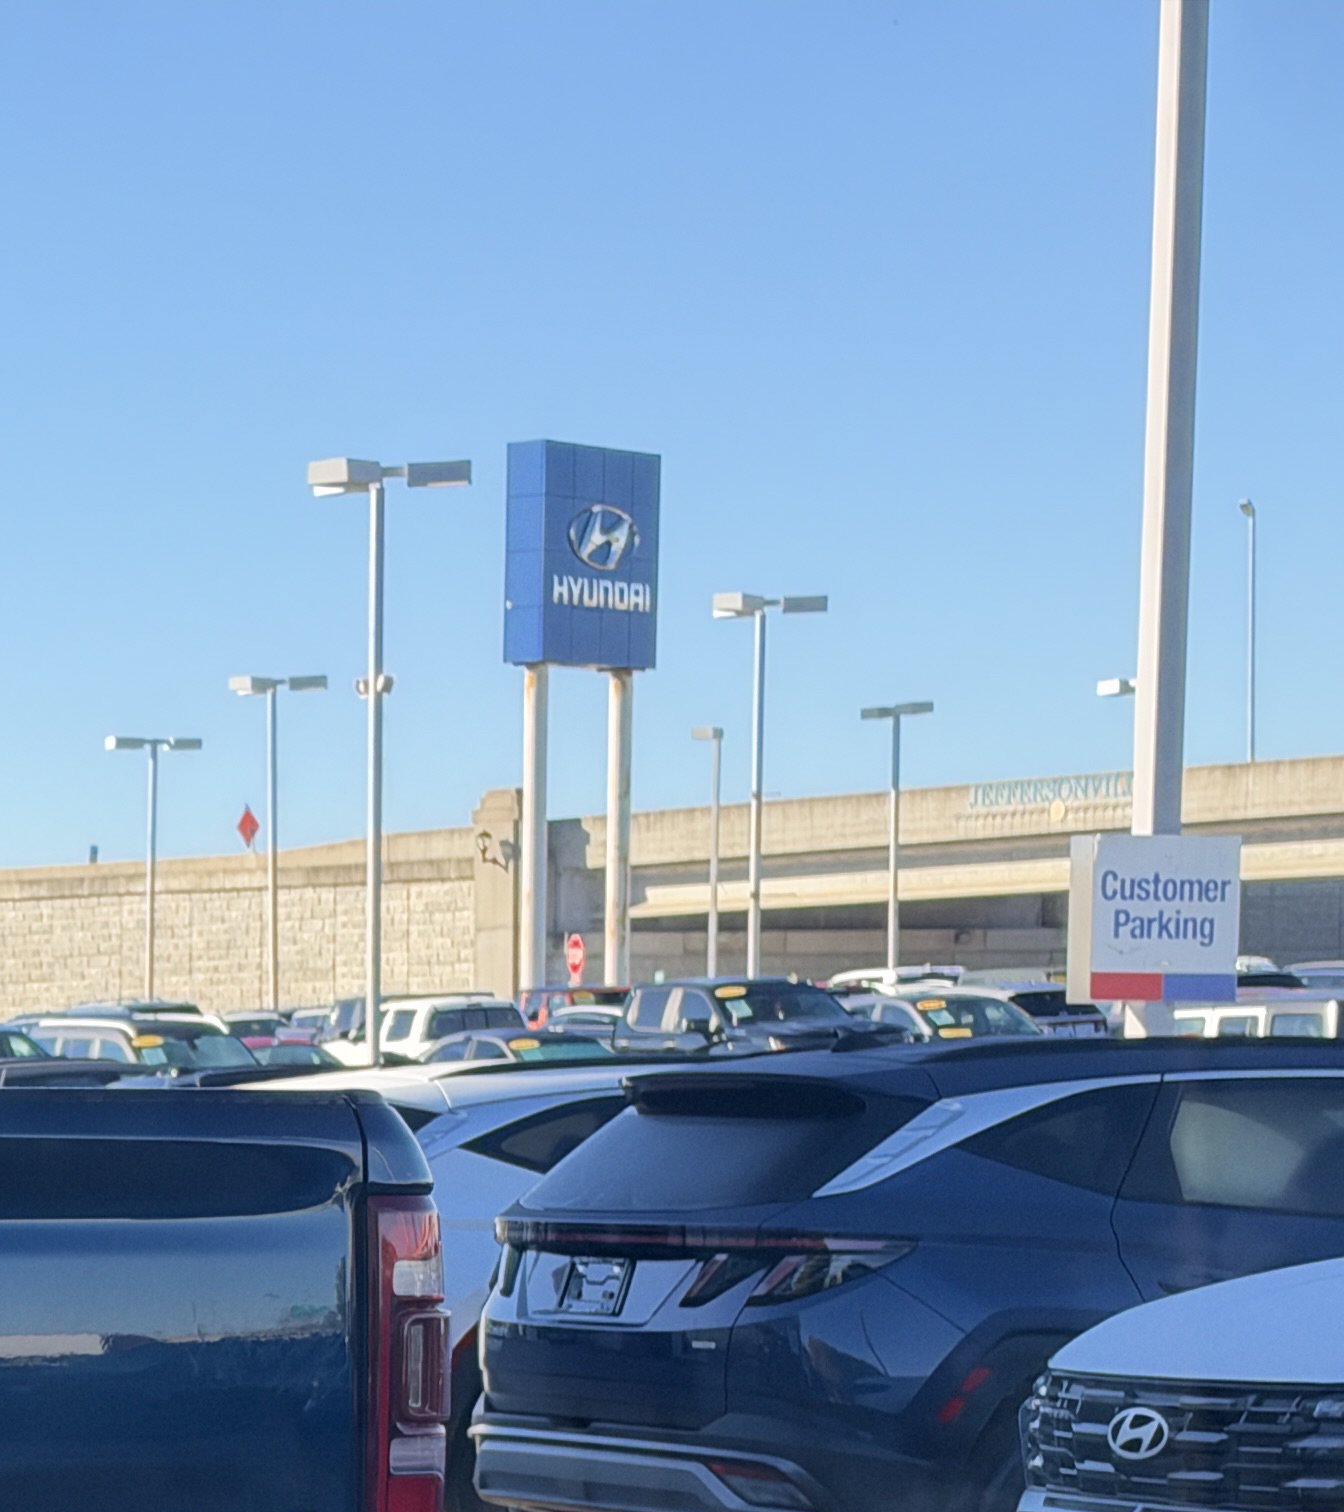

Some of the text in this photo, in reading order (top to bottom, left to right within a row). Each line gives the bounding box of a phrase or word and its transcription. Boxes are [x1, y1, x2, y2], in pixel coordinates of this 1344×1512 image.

[552, 574, 651, 613] HYUNDAI
[1100, 869, 1232, 902] Customer
[1112, 909, 1215, 948] Parking
